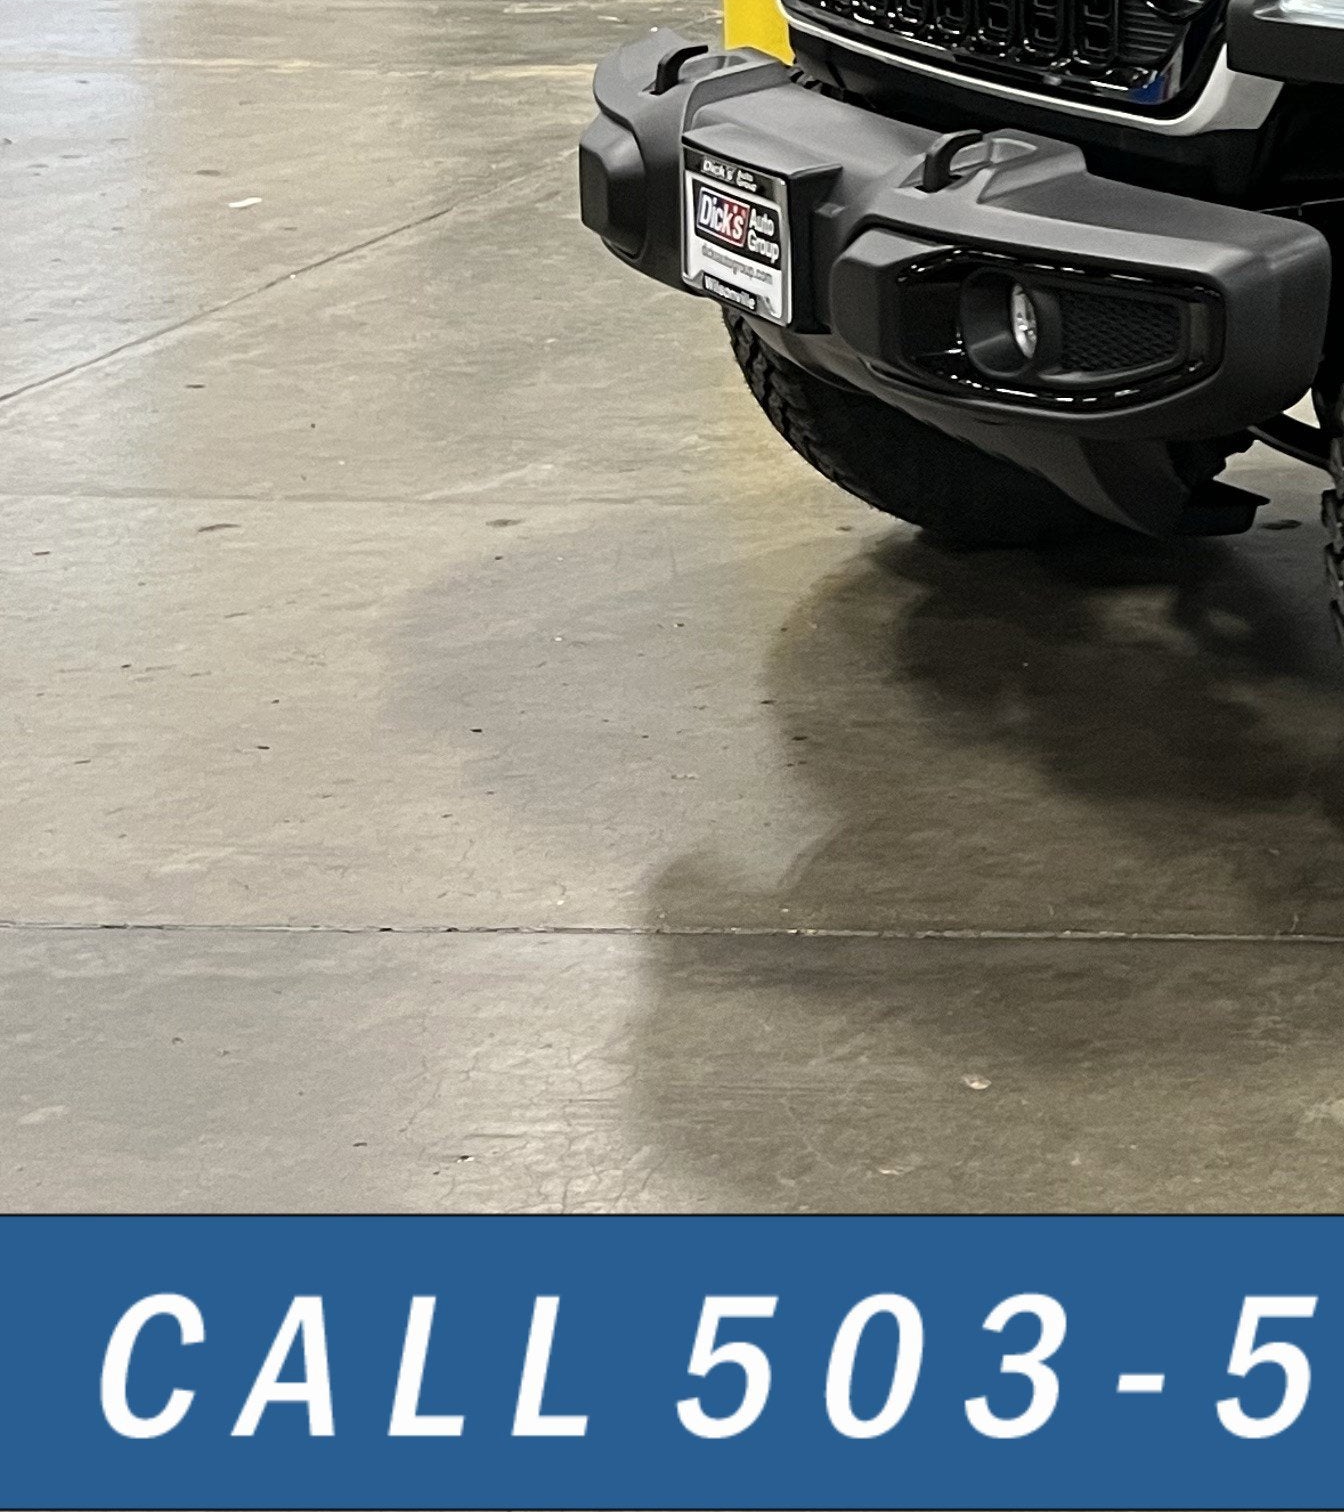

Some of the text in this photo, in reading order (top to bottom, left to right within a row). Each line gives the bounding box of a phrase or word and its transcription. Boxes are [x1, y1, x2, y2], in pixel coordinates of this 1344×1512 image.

[699, 194, 744, 241] Dick's
[749, 207, 775, 237] Auto
[747, 229, 780, 264] Group
